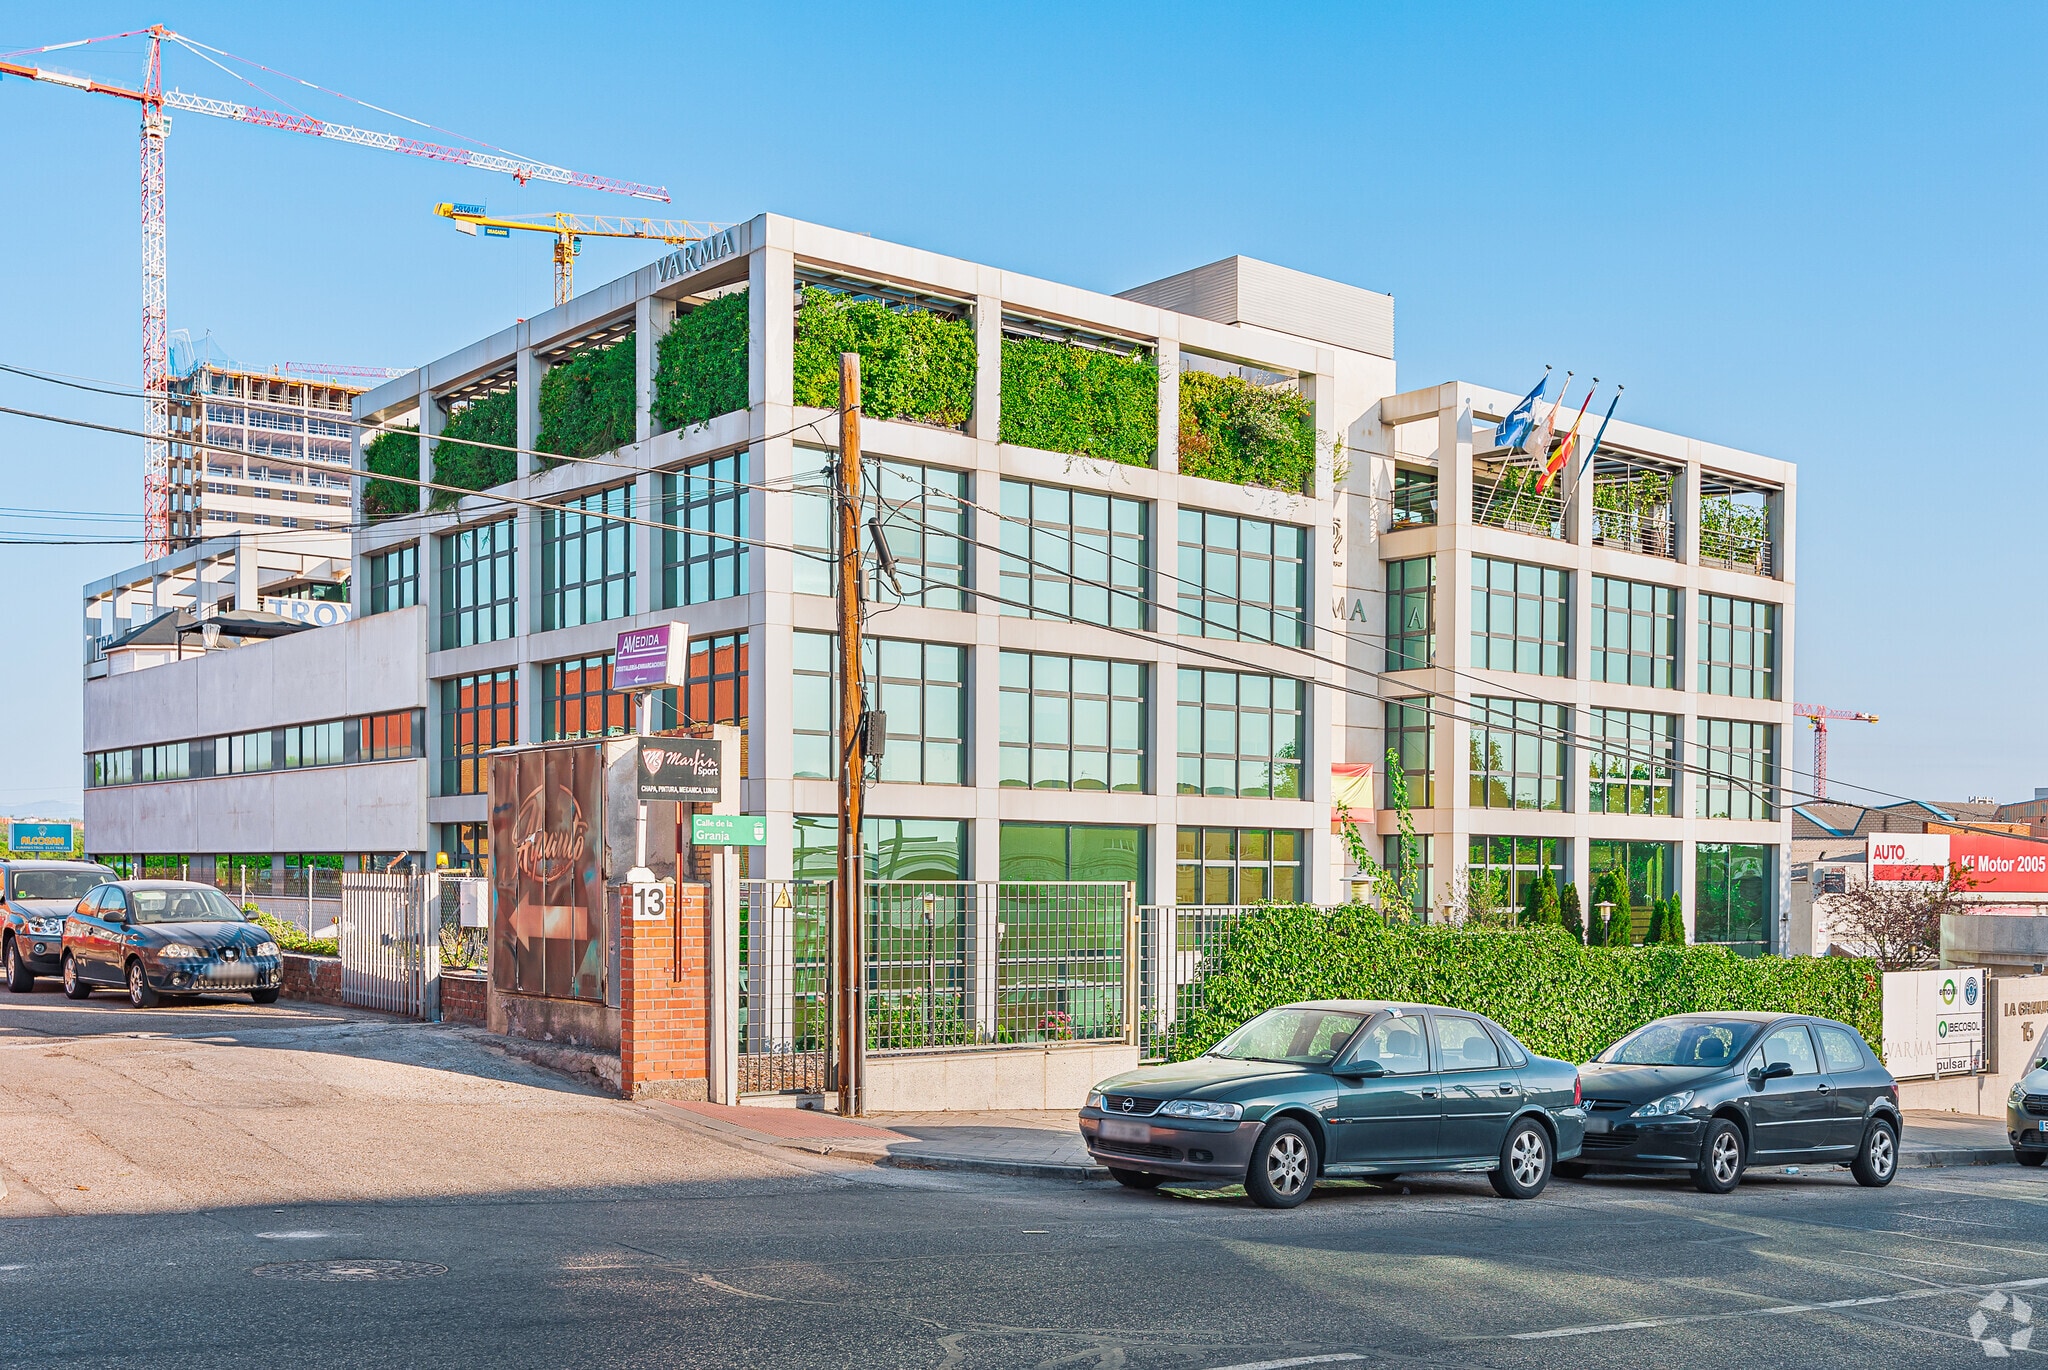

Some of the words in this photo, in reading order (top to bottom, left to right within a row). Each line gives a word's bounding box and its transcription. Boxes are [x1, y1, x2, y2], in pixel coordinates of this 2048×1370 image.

[655, 230, 735, 282] VARMA
[665, 748, 718, 776] Marfin
[697, 766, 719, 778] Sport
[641, 784, 658, 794] CHAPA,
[703, 787, 719, 795] LUNAS
[695, 818, 715, 828] Calle
[715, 819, 726, 828] de
[726, 820, 734, 828] la
[695, 829, 730, 843] Granja
[1873, 844, 1905, 861] AUTO
[1978, 855, 2014, 873] Motor
[2017, 856, 2046, 873] 2005
[634, 888, 665, 916] 13
[2004, 1002, 2017, 1017] LA
[2021, 1021, 2034, 1042] 15
[1886, 1040, 1934, 1060] VARMA
[1936, 1059, 1968, 1072] pulsar
